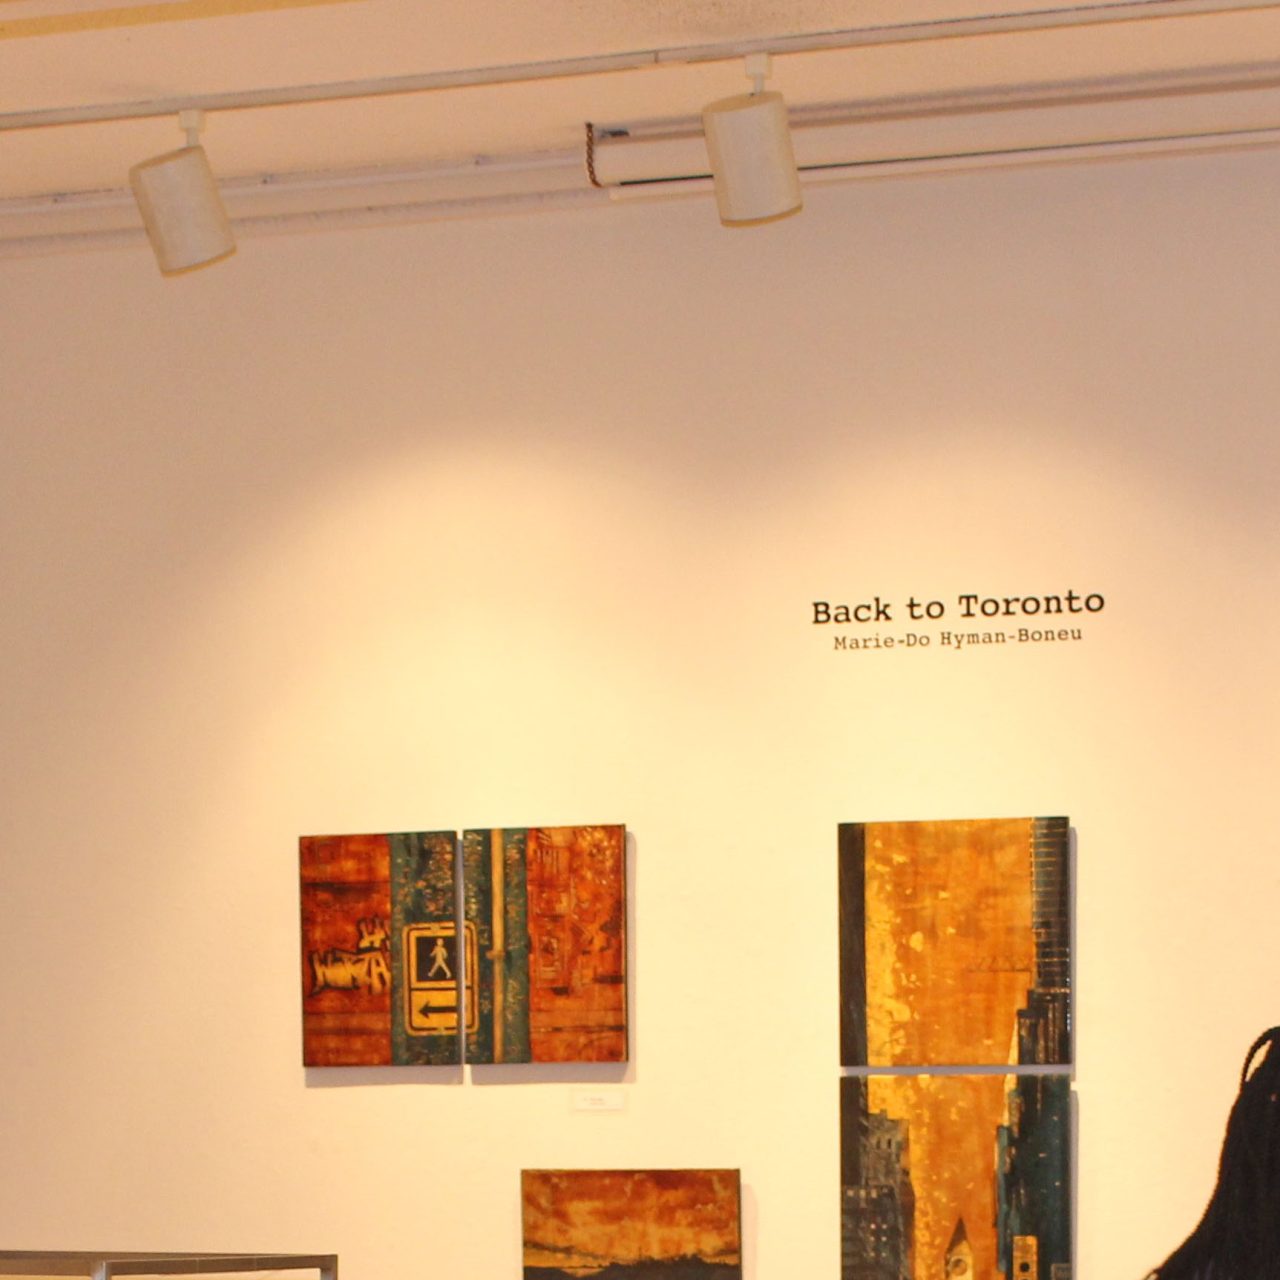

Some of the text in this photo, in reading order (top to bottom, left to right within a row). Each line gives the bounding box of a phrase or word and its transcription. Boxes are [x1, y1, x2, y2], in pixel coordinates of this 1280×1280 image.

[811, 588, 1106, 625] Back to Toronto
[833, 627, 1083, 651] Marie-Do Hyman-Boneu
